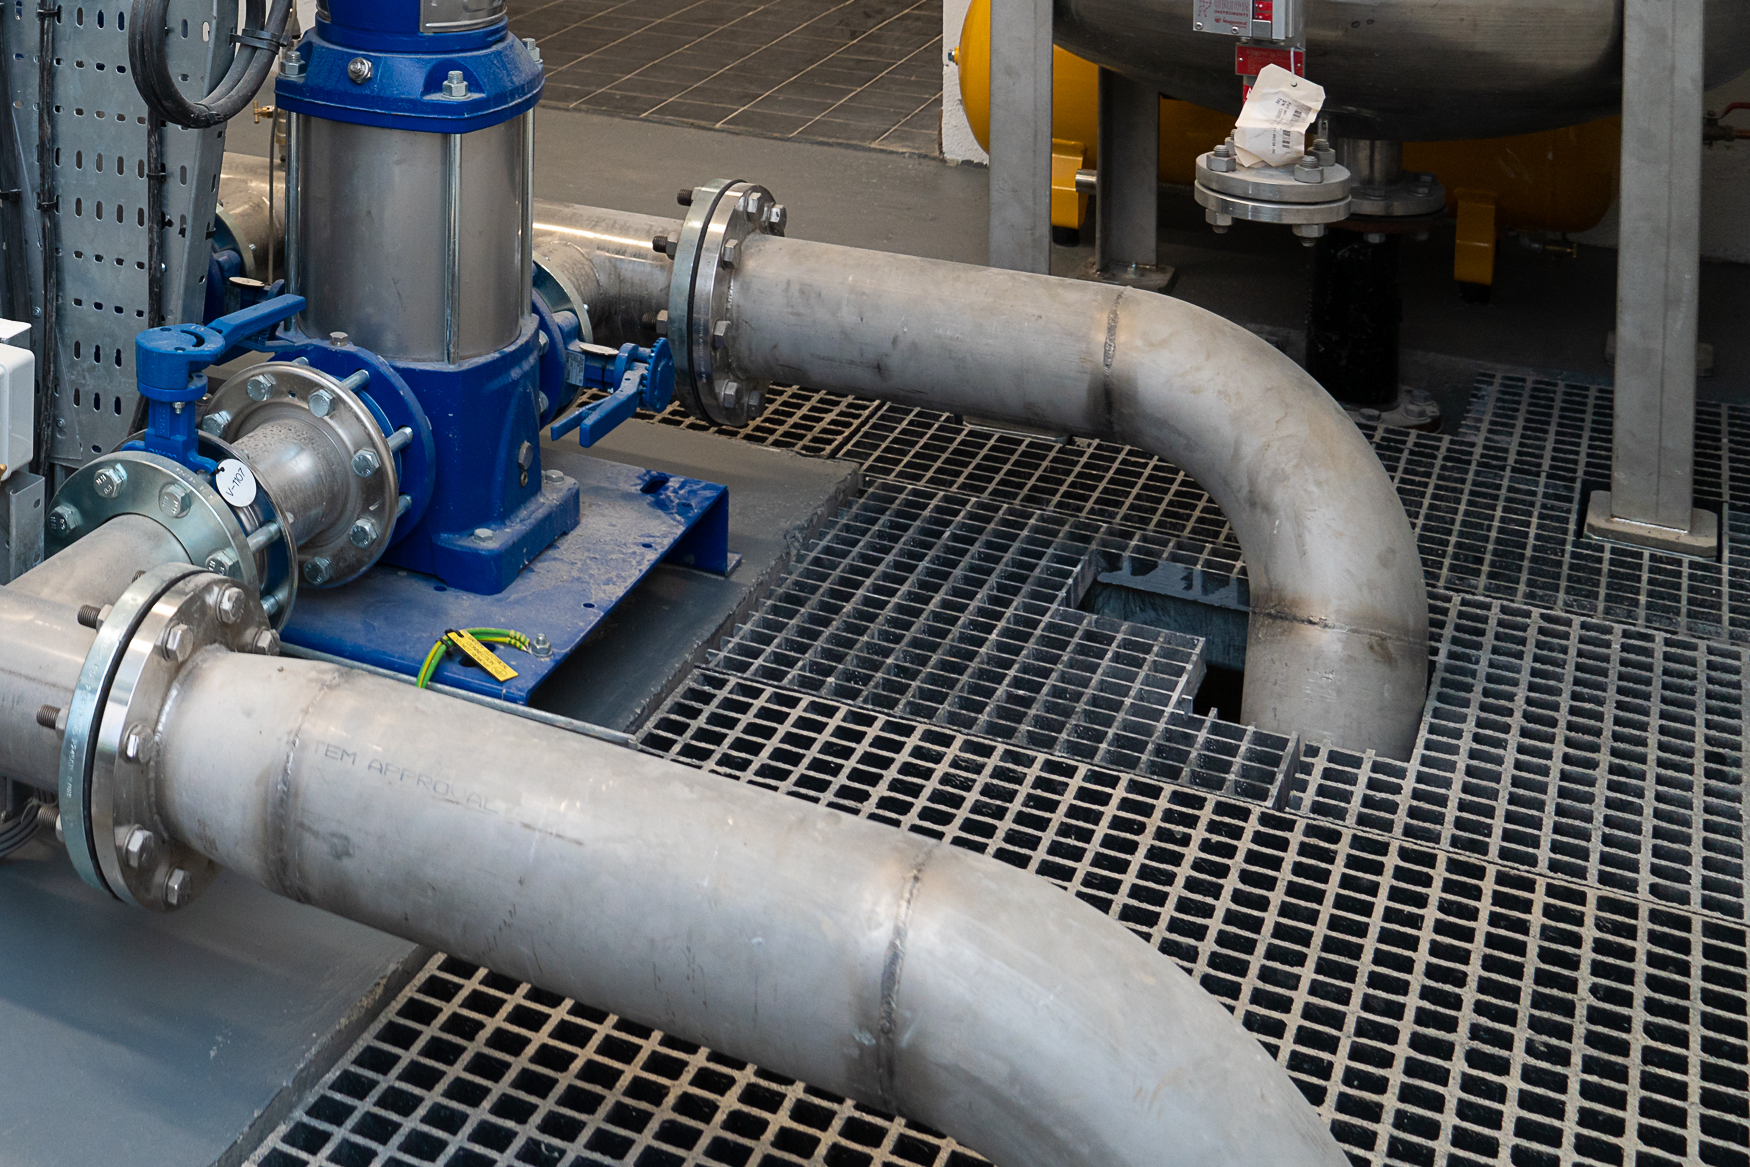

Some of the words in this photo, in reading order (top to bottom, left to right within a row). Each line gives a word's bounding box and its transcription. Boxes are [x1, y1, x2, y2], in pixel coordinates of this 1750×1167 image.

[1214, 10, 1249, 18] INSTRUMENTS
[225, 467, 246, 497] V-1107
[367, 758, 499, 814] APPROVAL
